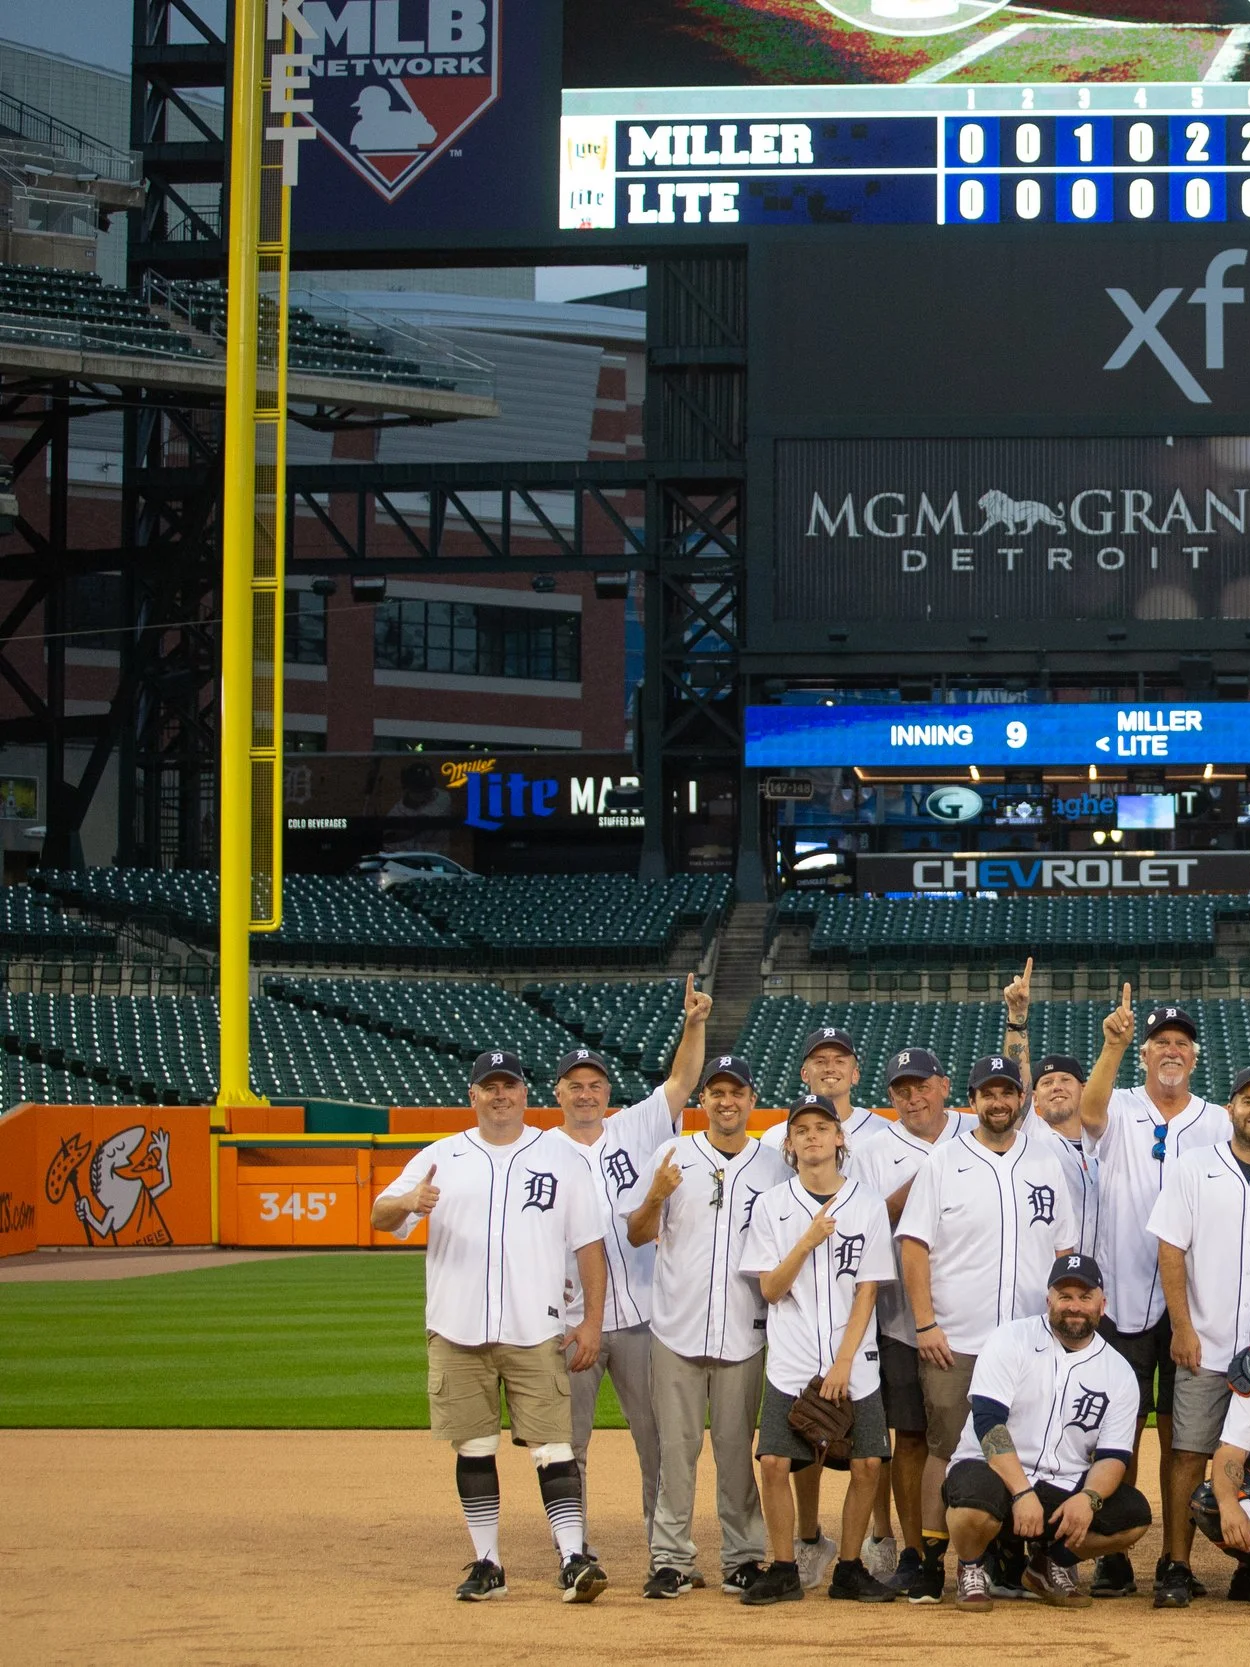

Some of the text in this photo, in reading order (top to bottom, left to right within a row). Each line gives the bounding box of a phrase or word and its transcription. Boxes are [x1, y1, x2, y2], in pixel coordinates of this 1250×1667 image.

[300, 0, 486, 55] MLB
[304, 57, 486, 77] NETWORK
[967, 87, 975, 109] 1
[1022, 87, 1034, 109] 2
[1078, 87, 1090, 109] 3
[1133, 87, 1147, 109] 4
[1191, 87, 1203, 109] 5
[628, 124, 814, 166] MILLER
[959, 122, 984, 163] 0
[1016, 122, 1041, 163] 0
[1073, 122, 1094, 163] 1
[1129, 122, 1154, 163] 0
[1186, 122, 1210, 163] 2
[628, 182, 740, 223] LITE
[959, 178, 984, 219] 0
[1016, 178, 1041, 219] 0
[1072, 178, 1097, 219] 0
[1129, 178, 1154, 219] 0
[1186, 178, 1210, 219] 0
[804, 490, 968, 537] MGM
[902, 547, 1210, 572] DETROIT
[891, 721, 1028, 748] INNING 9
[1117, 711, 1203, 732] MILLER
[1117, 735, 1168, 757] LITE
[441, 758, 496, 788] Miller
[464, 772, 560, 830] Lite
[288, 819, 347, 829] COLD BEVERAGES
[599, 816, 629, 827] STUFFED
[913, 858, 1199, 889] CHEVROLET
[521, 1167, 559, 1213] D
[1024, 1179, 1055, 1228] D
[834, 1229, 866, 1280] D
[1063, 1381, 1110, 1433] D
